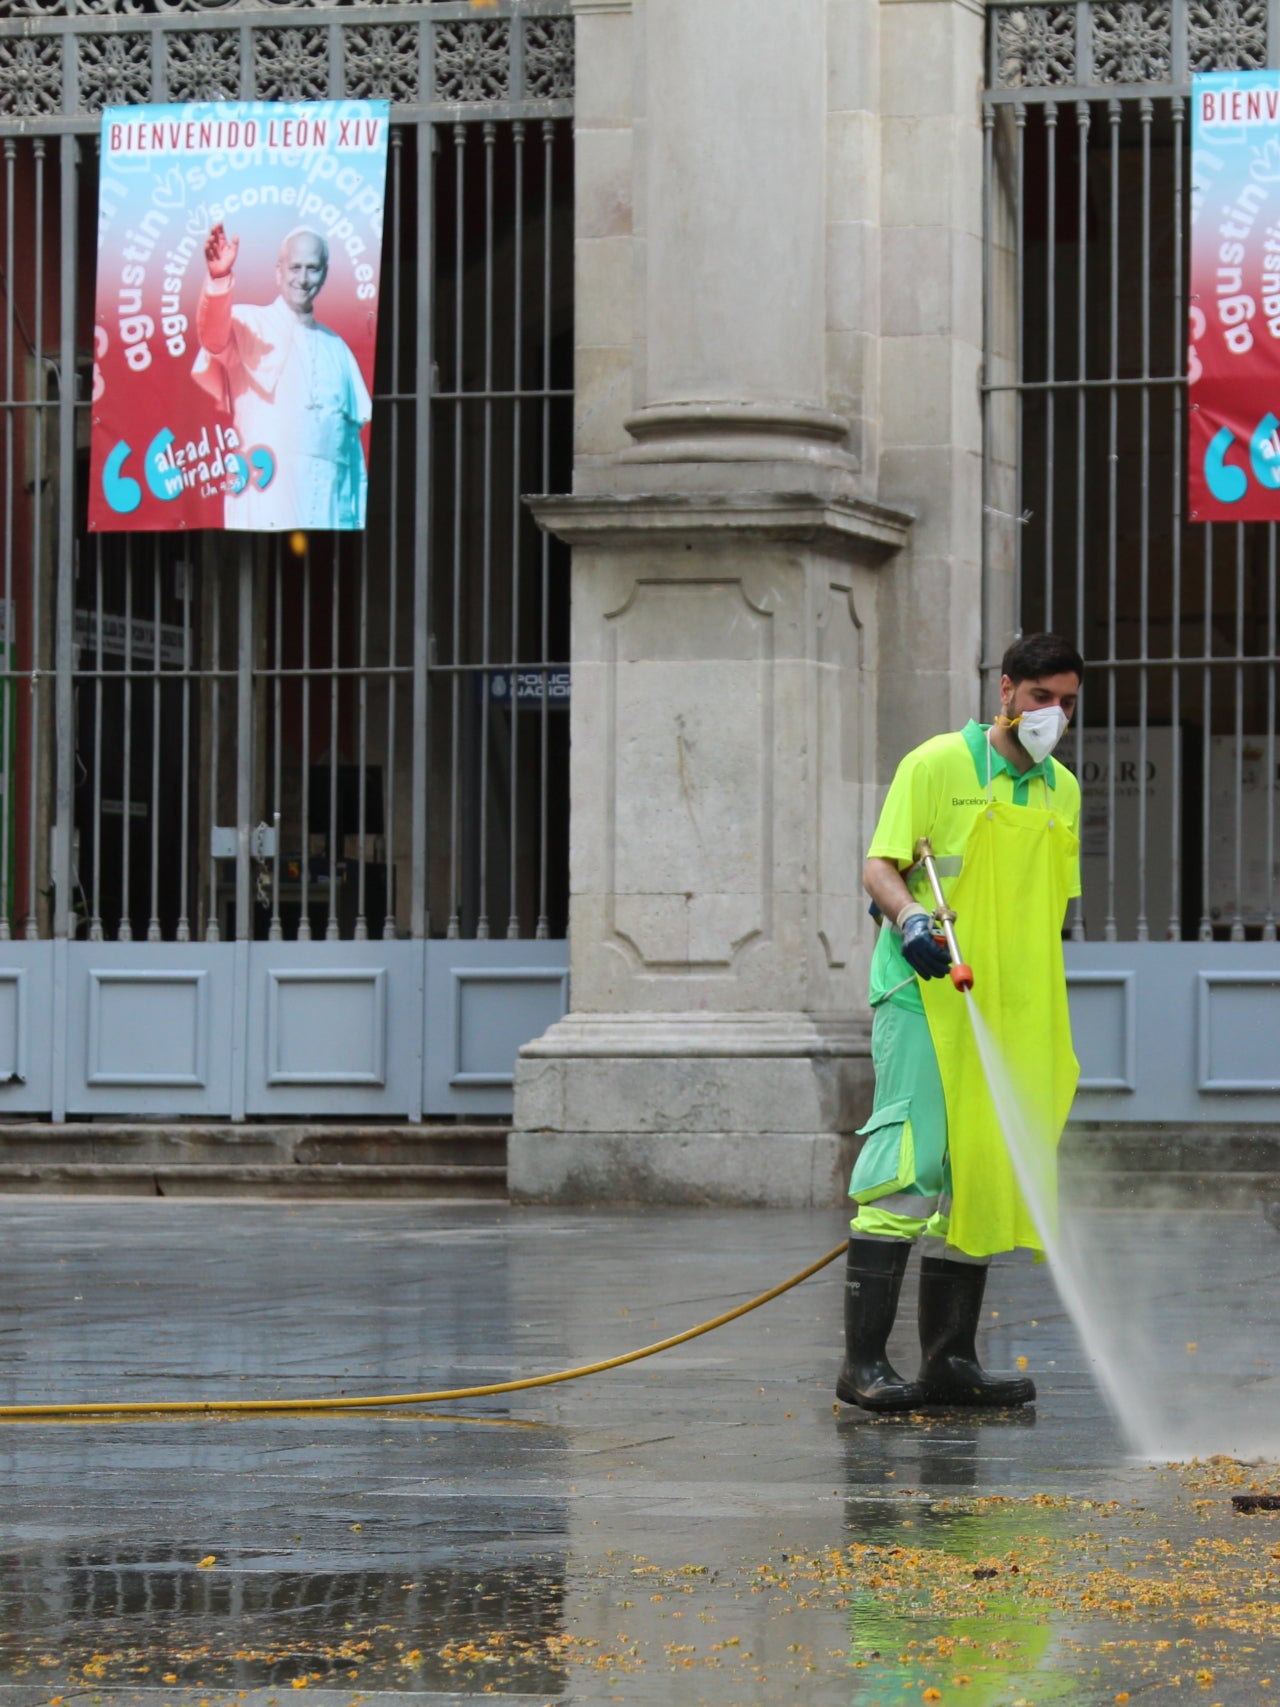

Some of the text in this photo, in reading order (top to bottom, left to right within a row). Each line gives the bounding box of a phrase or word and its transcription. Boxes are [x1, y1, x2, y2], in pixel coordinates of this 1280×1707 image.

[111, 121, 257, 151] BIENVENIDO
[269, 112, 327, 147] LEÓN
[338, 119, 379, 147] XIV
[154, 424, 240, 473] alzad la
[164, 446, 241, 496] mirada
